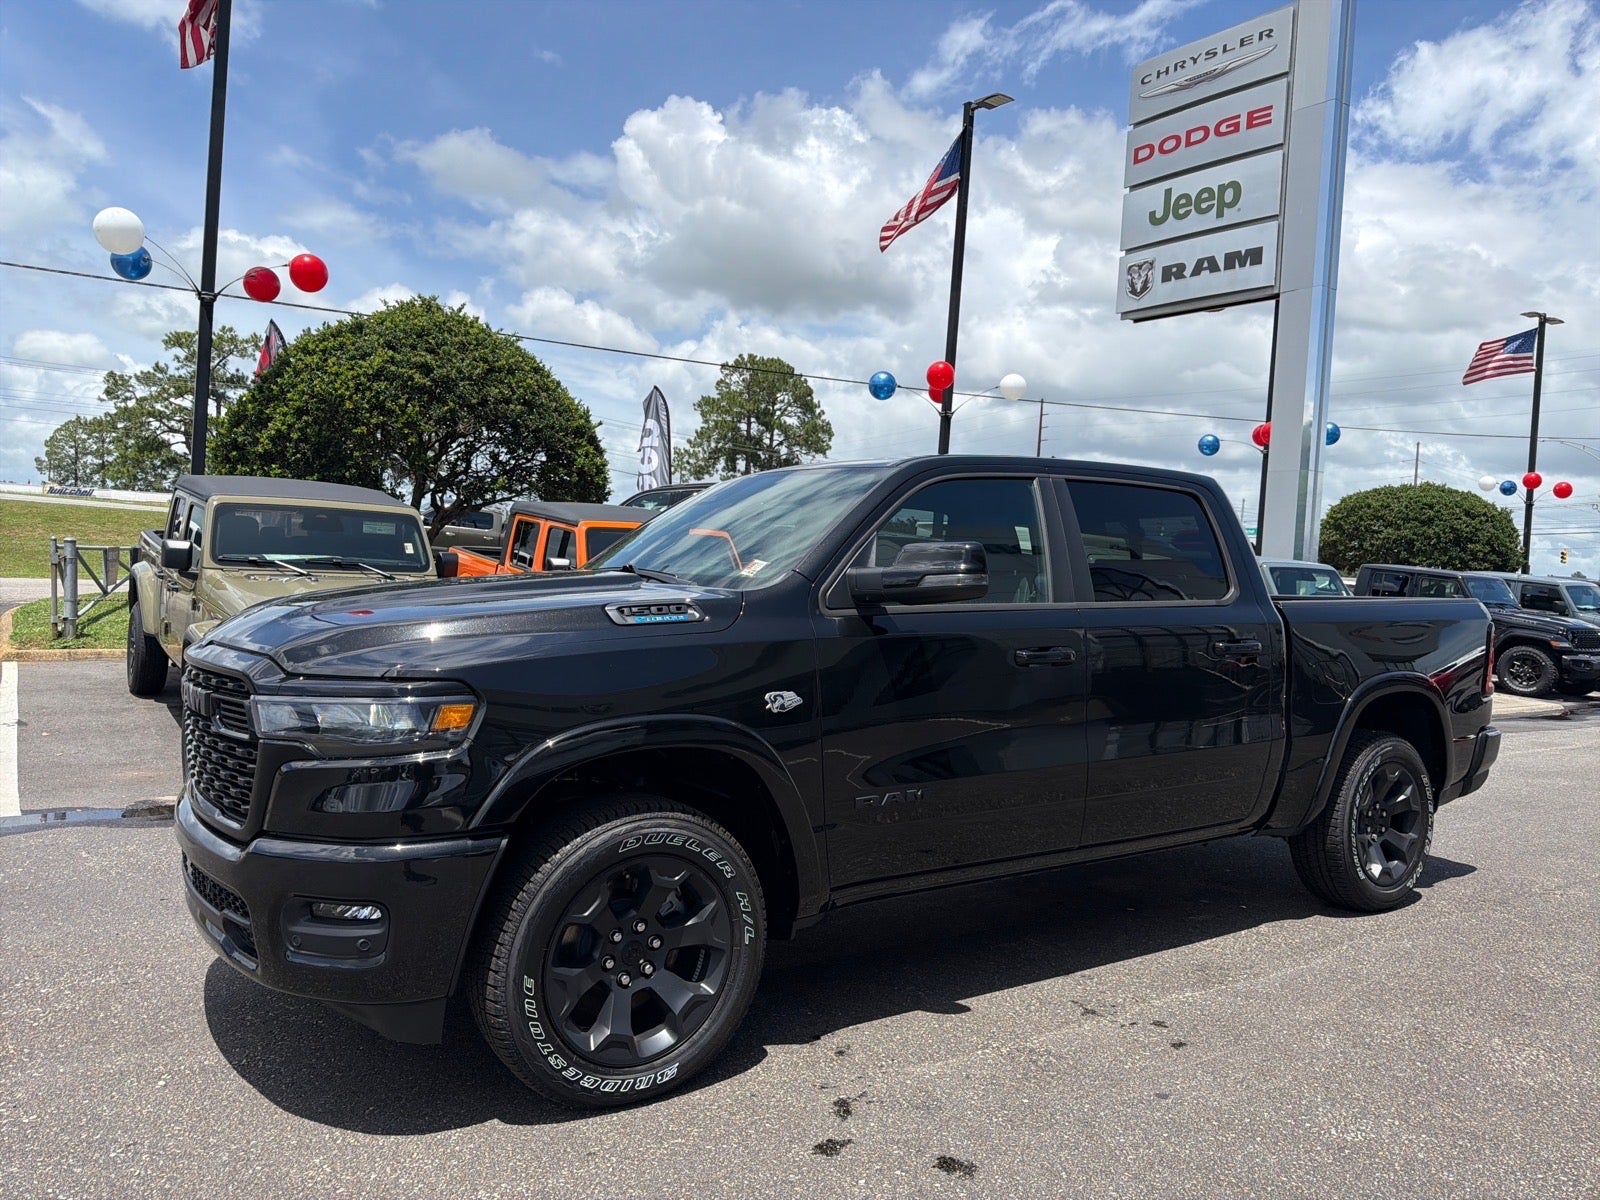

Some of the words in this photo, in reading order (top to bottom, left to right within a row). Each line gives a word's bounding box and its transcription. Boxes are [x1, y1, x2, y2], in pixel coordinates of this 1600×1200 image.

[1140, 28, 1274, 85] CHRYSLER
[1133, 105, 1274, 165] DODGE
[1148, 180, 1242, 226] Jeep
[1161, 246, 1264, 283] RAM
[620, 604, 688, 616] 1500
[618, 833, 738, 879] DUELER
[523, 975, 680, 1092] BRIDGESTONE
